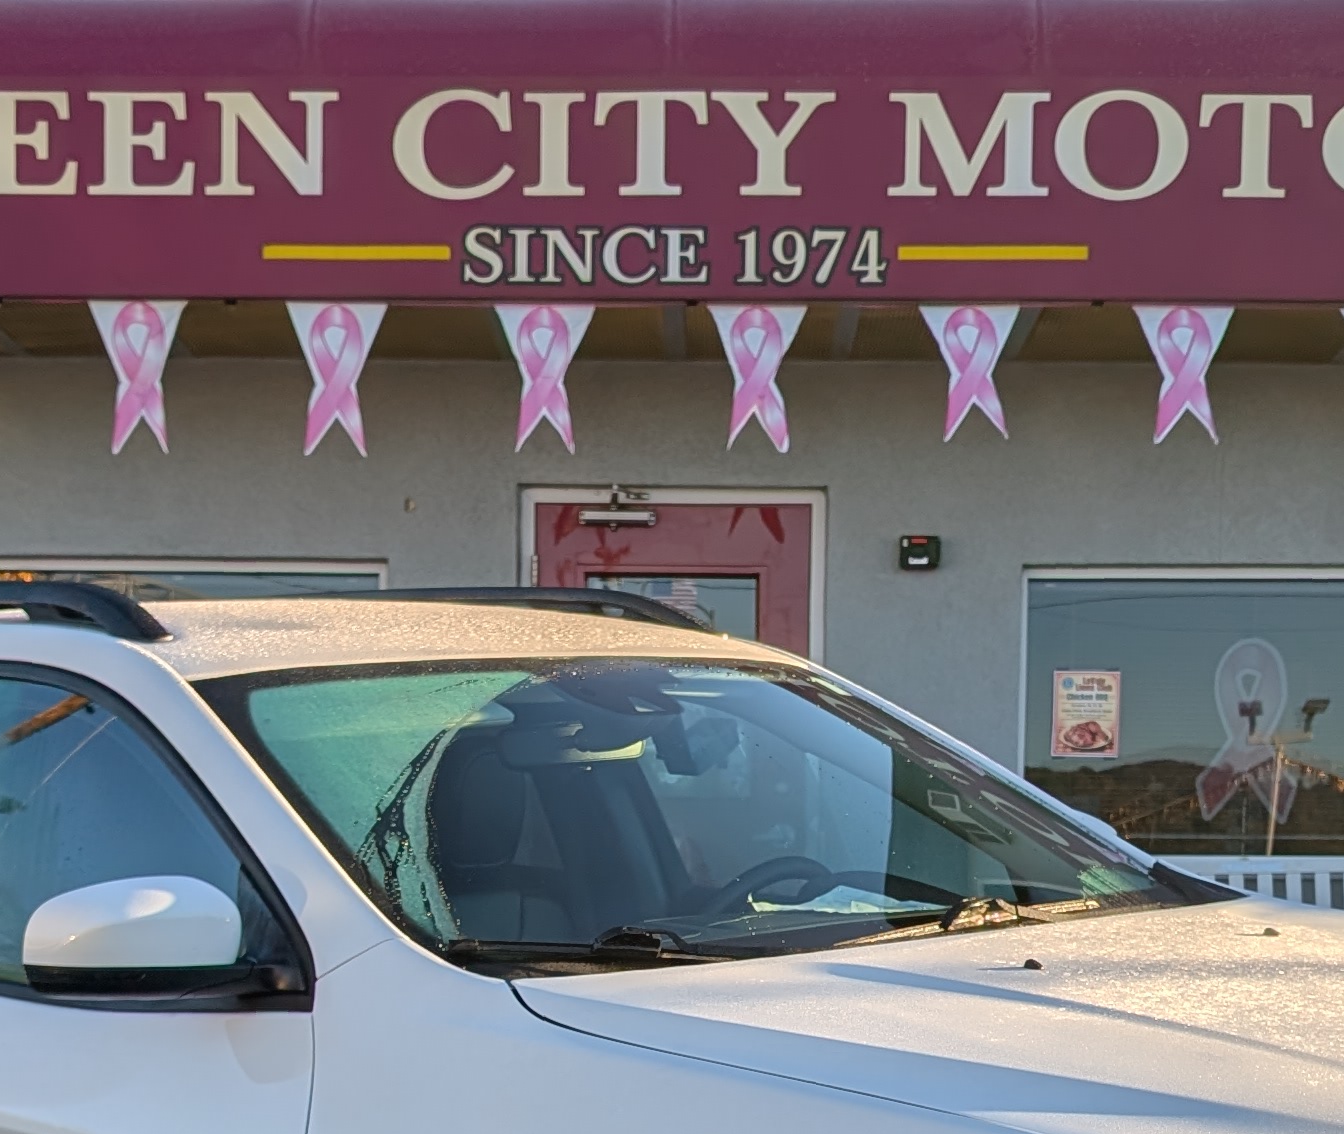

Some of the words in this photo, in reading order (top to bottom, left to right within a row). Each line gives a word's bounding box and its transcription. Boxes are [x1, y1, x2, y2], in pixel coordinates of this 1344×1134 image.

[392, 88, 837, 200] CITY
[462, 226, 709, 285] SINCE
[734, 227, 887, 286] 1974
